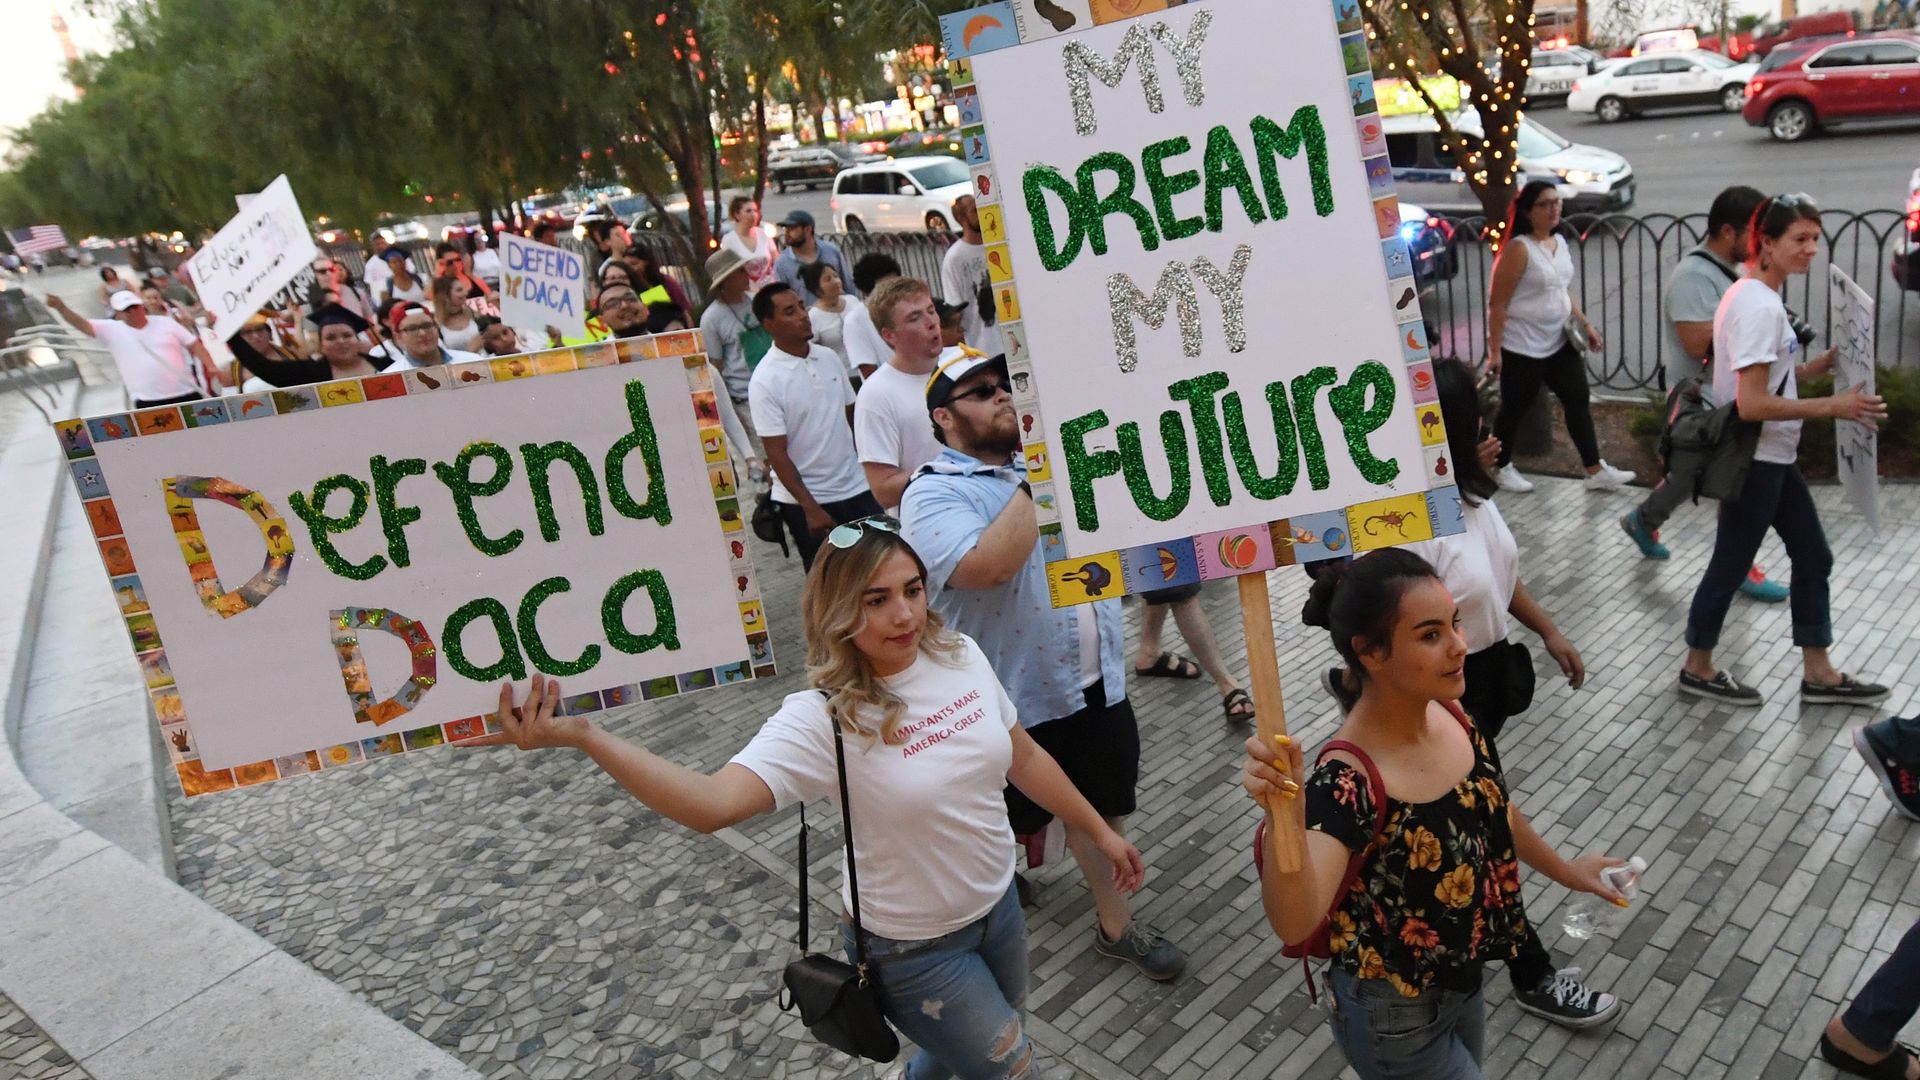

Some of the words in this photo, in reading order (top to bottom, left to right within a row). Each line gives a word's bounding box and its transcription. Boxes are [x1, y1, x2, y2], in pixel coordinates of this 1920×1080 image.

[943, 32, 954, 57] LUNA
[1063, 7, 1213, 136] MY
[1540, 80, 1574, 91] POLI
[1022, 105, 1335, 272] DREAM
[508, 241, 580, 281] DEFEND
[524, 278, 574, 318] DACA
[1106, 243, 1253, 373] MY
[1193, 535, 1202, 547] LA
[1196, 548, 1208, 579] SANDIA
[953, 689, 981, 710] MAKE
[902, 728, 955, 759] AMERICA
[954, 708, 986, 732] GREAT
